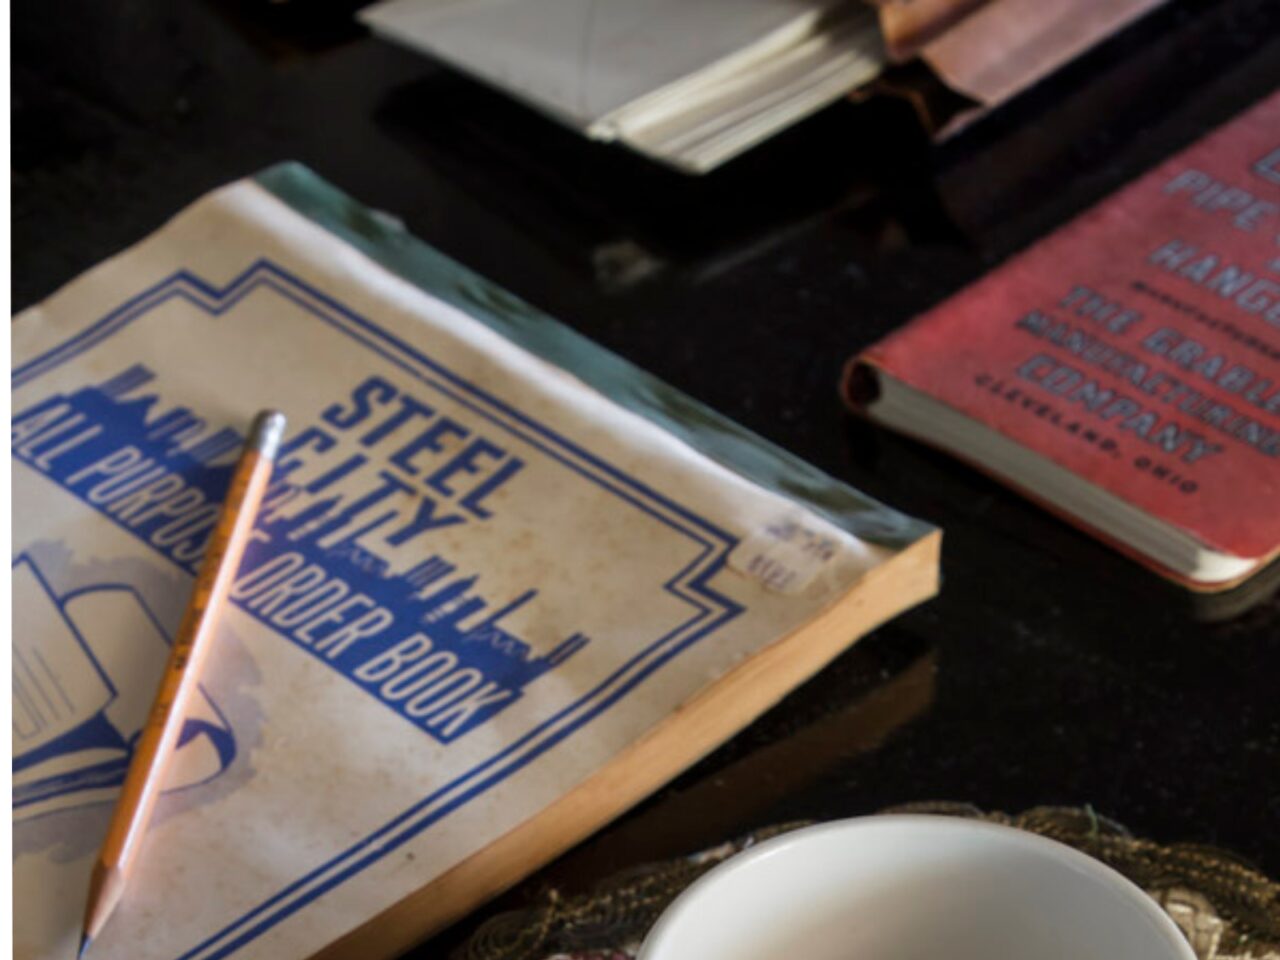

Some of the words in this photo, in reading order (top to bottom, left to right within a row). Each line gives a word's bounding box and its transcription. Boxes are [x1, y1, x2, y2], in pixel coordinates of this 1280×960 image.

[1162, 168, 1279, 232] PIPE
[1059, 284, 1144, 335] THE
[322, 375, 527, 521] STEEL
[974, 373, 1121, 459] CLEVELAND,
[1133, 456, 1199, 495] OHIO
[1016, 353, 1224, 465] COMPANY
[269, 426, 467, 548] CITY
[11, 402, 105, 471] ALL
[65, 444, 271, 562] PURPOS
[231, 551, 395, 660] ORDER
[353, 631, 512, 738] BOOK
